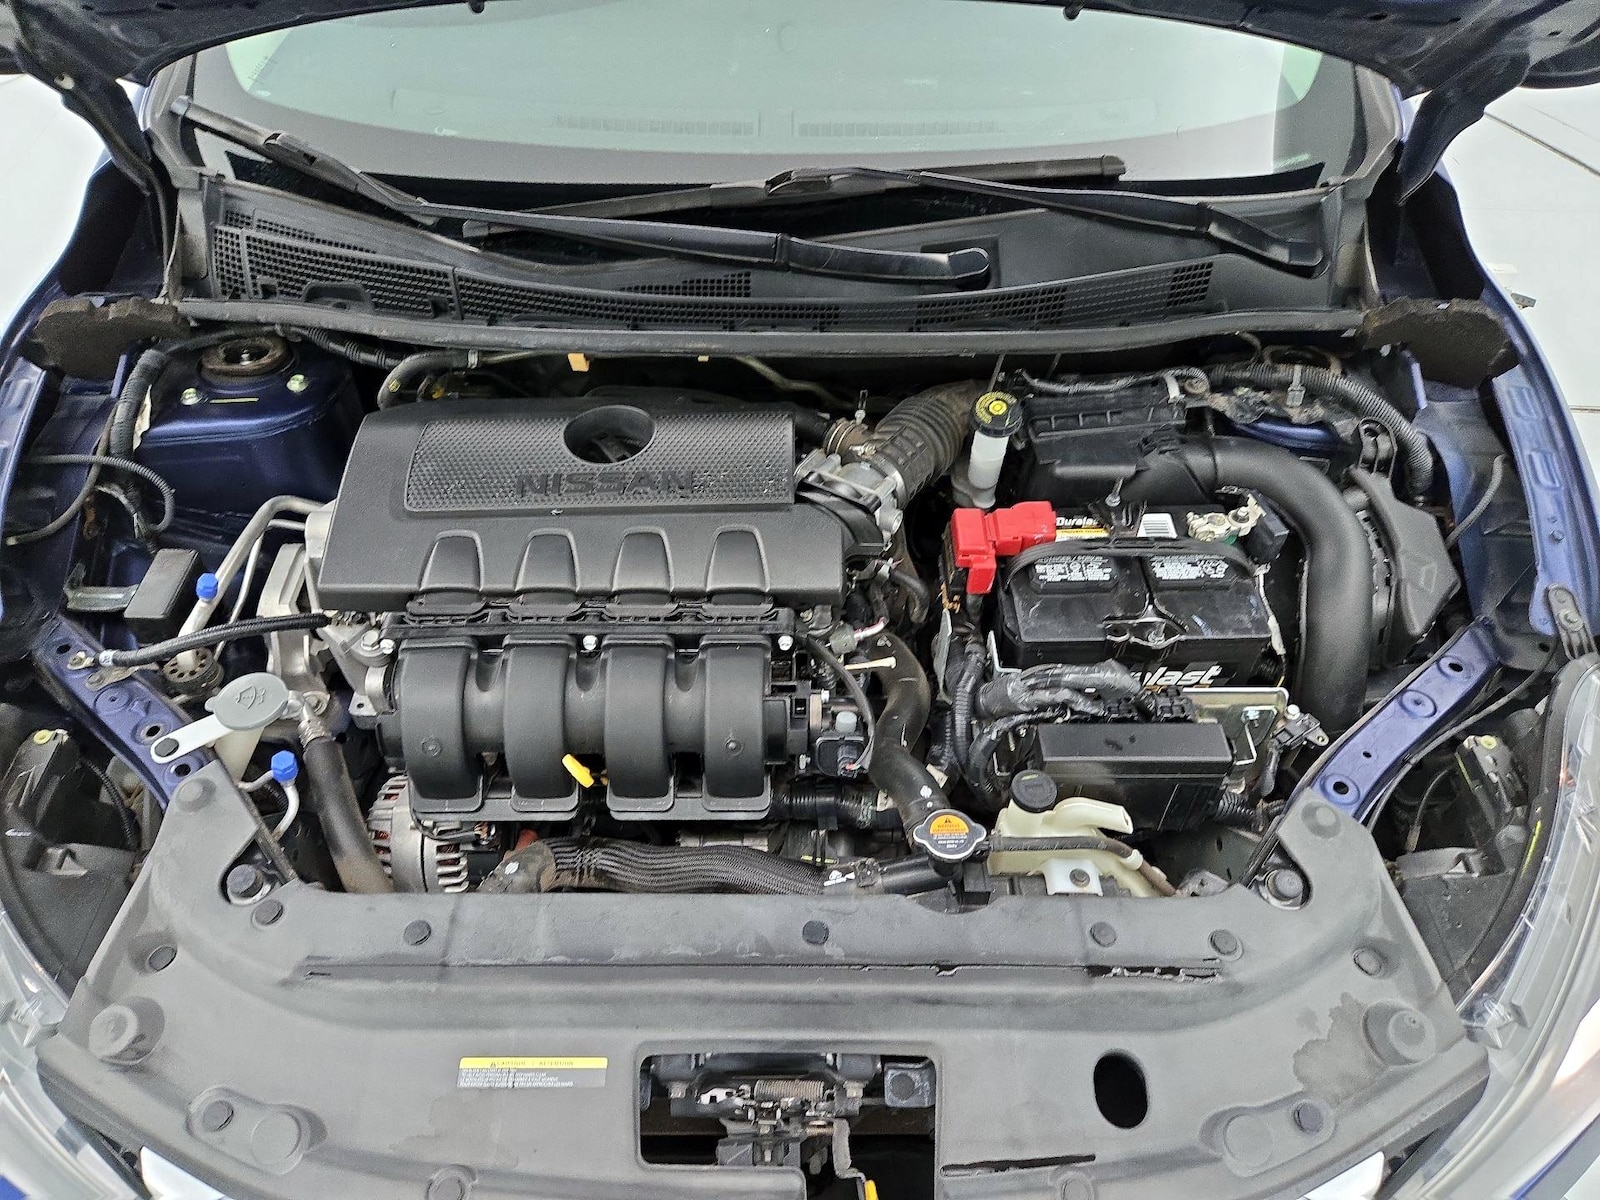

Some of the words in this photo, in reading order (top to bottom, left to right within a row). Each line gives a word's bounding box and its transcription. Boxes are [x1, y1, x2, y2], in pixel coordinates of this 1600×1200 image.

[515, 470, 694, 496] NISSAN
[1056, 516, 1098, 527] Durala
[1130, 665, 1222, 686] alast
